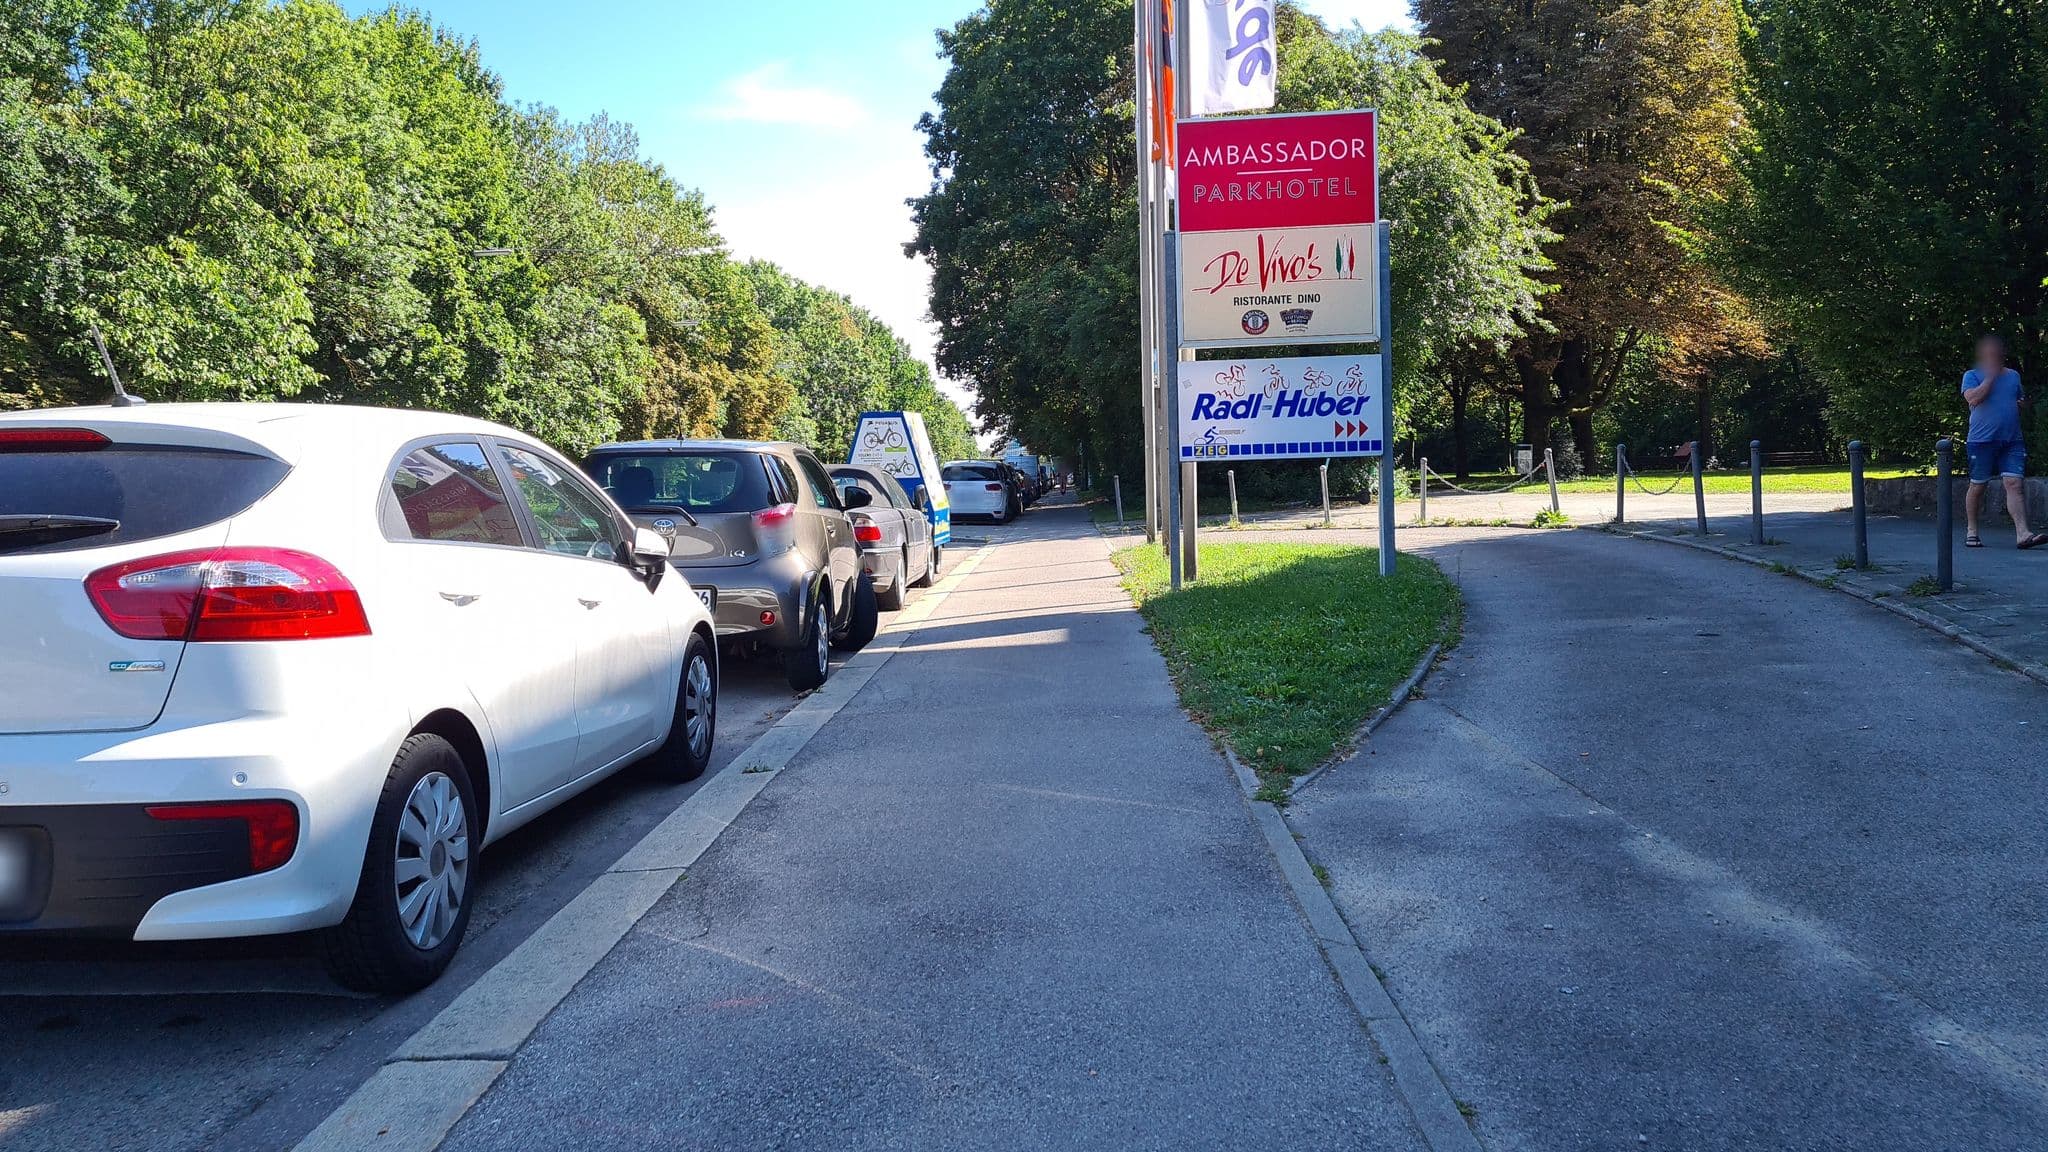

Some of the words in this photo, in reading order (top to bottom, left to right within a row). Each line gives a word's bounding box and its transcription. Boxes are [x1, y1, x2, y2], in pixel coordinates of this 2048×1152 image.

[1184, 138, 1366, 167] AMBASSADOR
[1193, 177, 1357, 203] PARKHOTEL
[1203, 250, 1249, 294] De
[1257, 233, 1323, 293] Vivo's
[1233, 294, 1292, 306] RISTORANTE
[1298, 293, 1321, 304] DINO
[1195, 445, 1228, 456] ZEG
